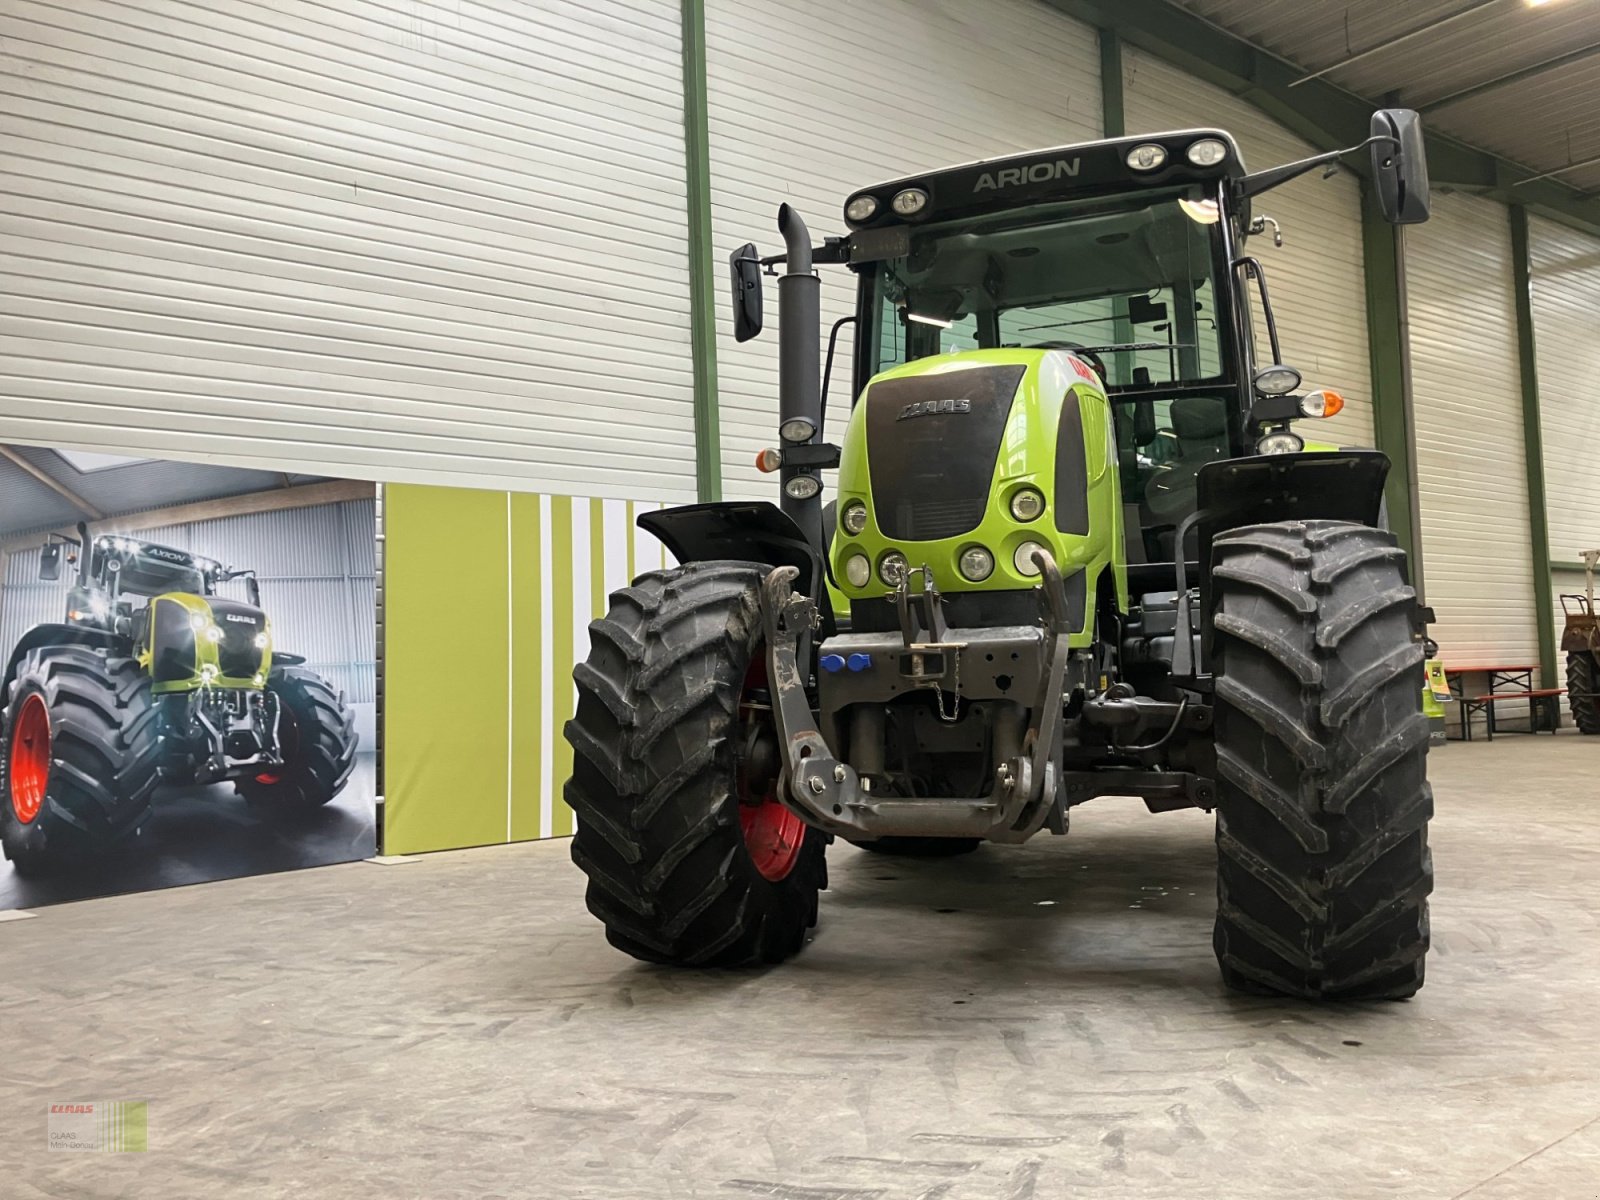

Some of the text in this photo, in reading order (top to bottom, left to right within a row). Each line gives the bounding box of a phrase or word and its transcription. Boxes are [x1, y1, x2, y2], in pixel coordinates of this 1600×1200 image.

[973, 157, 1080, 193] ARION
[896, 399, 970, 421] CLAAS
[148, 548, 186, 562] AXION
[226, 613, 256, 625] CLAAS
